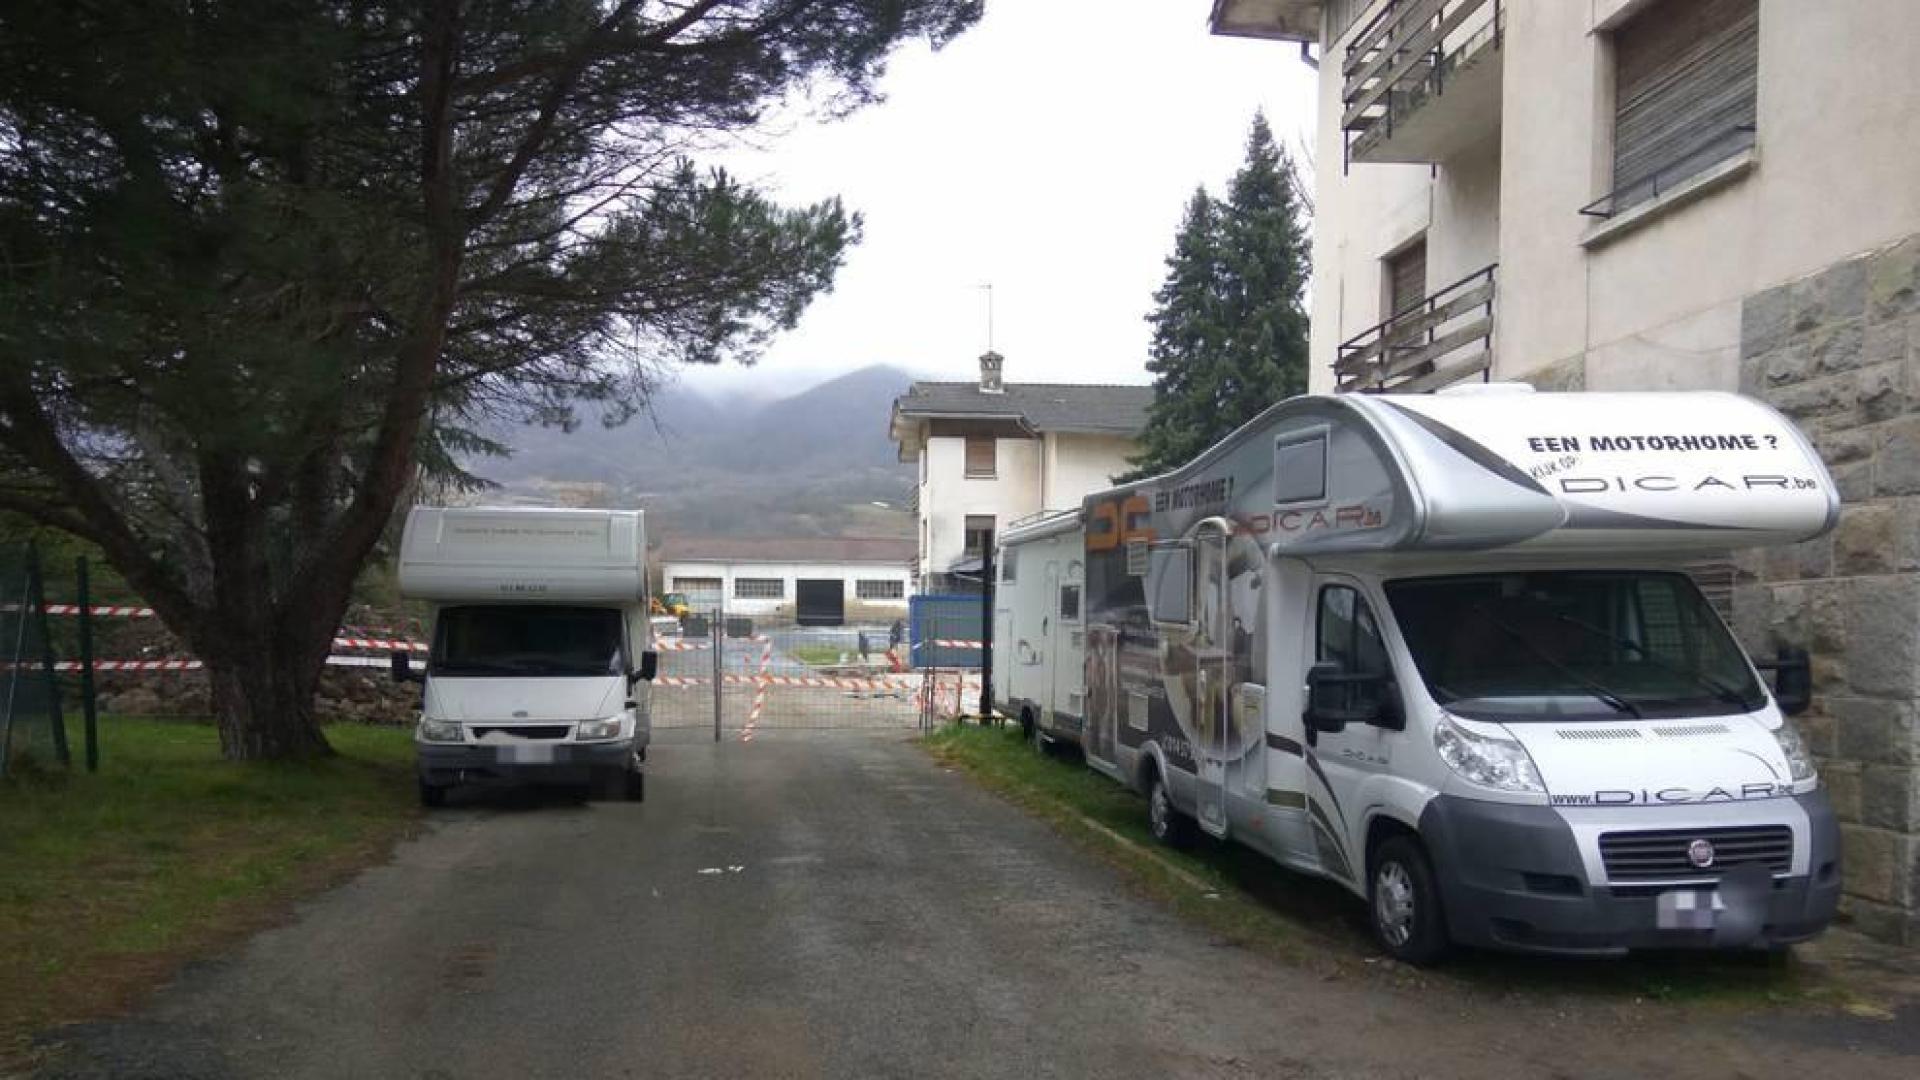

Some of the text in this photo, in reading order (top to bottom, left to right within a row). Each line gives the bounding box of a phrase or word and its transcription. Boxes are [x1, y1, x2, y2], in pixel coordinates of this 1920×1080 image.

[1527, 434, 1778, 452] EEN MOTORHOME ?
